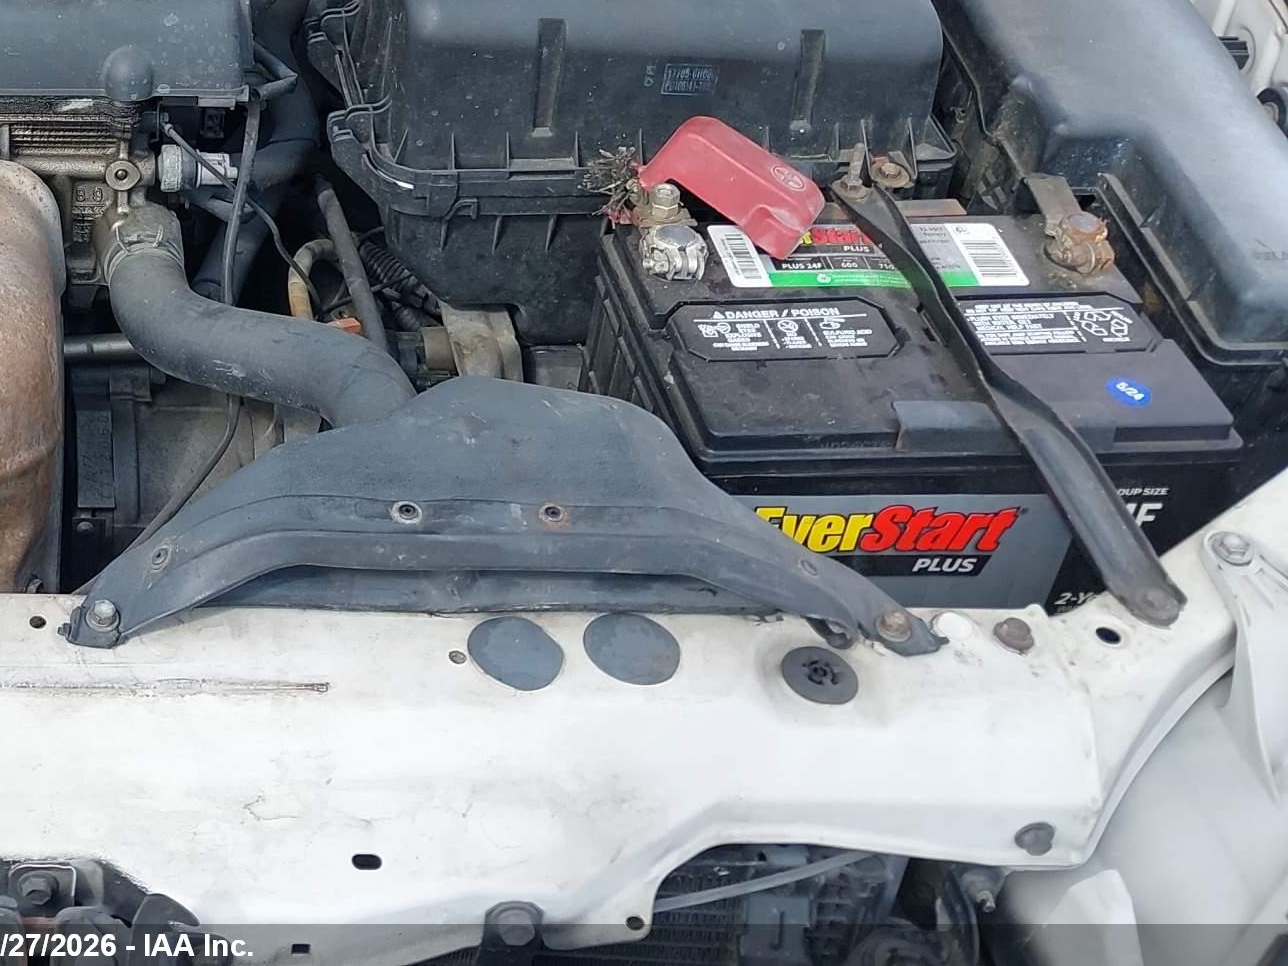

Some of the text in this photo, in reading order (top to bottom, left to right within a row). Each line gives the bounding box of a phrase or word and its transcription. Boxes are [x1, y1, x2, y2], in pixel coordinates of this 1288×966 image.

[843, 245, 870, 253] PLUS
[725, 310, 779, 319] DANGER
[791, 307, 840, 316] POISON
[1116, 487, 1170, 496] OUP SIZE
[912, 557, 978, 573] PLUS
